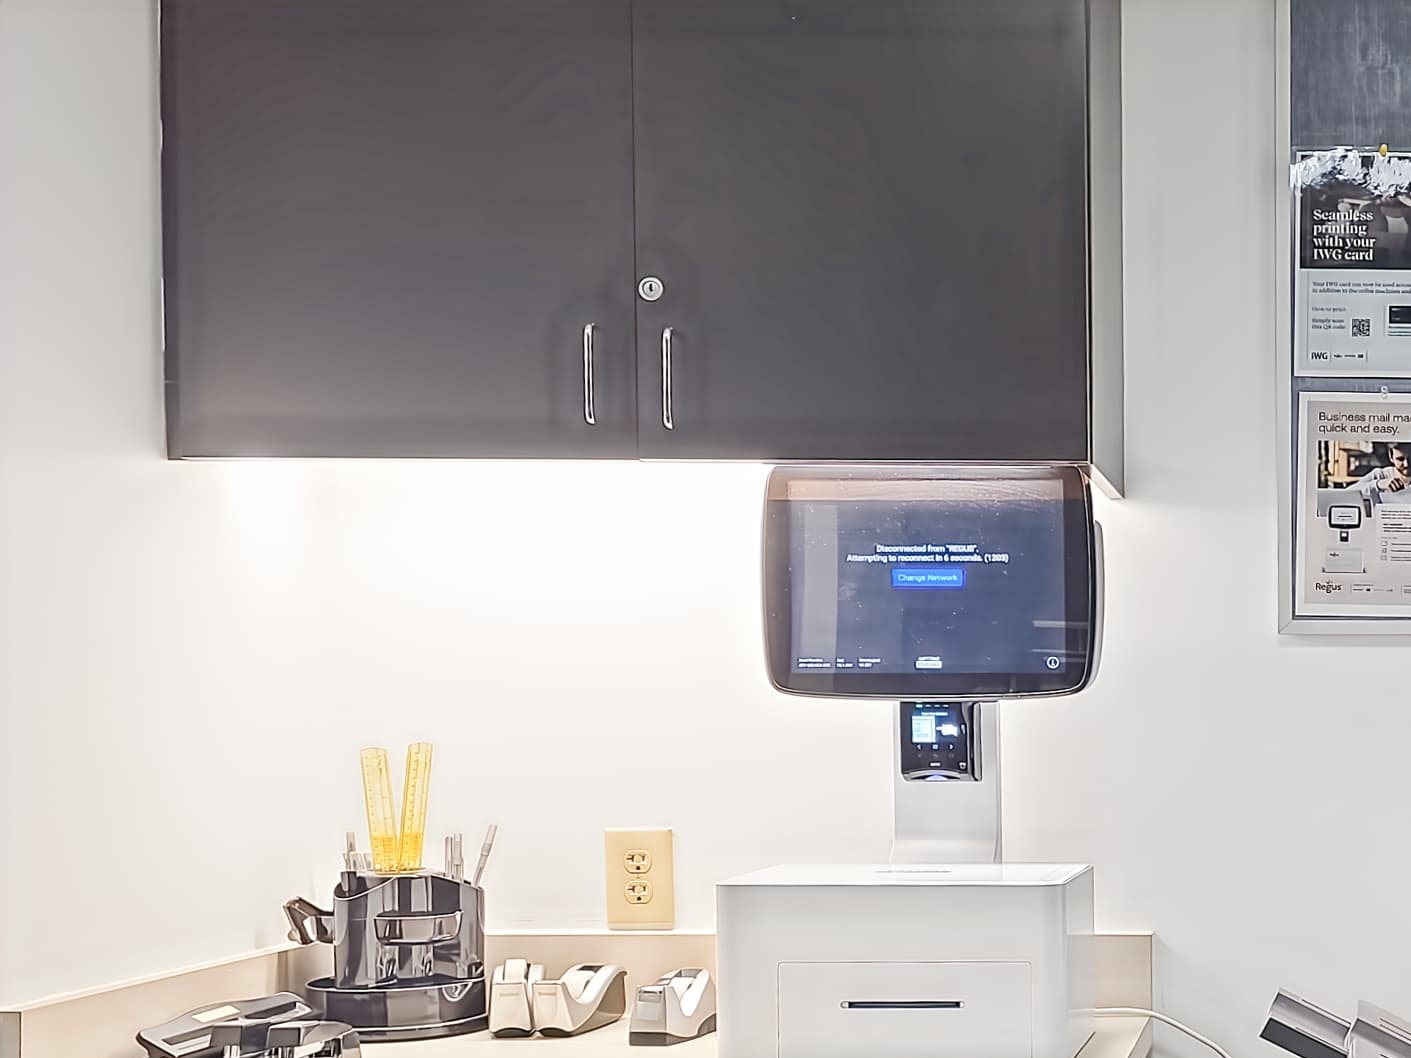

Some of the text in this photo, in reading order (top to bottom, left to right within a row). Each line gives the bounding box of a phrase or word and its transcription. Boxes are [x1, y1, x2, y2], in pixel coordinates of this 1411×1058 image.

[1313, 209, 1375, 221] Seamless
[1313, 222, 1367, 237] printing
[1313, 235, 1377, 249] with your
[1313, 249, 1374, 260] IWG card
[1311, 351, 1328, 360] IWG
[1319, 412, 1366, 422] Business
[1369, 413, 1390, 422] mail
[1319, 423, 1399, 436] quick and easy.
[876, 545, 926, 553] Disconnected
[928, 545, 945, 553] from
[846, 554, 888, 563] Attempting
[888, 554, 897, 563] to
[898, 554, 935, 563] reconnect
[935, 554, 943, 563] in
[898, 574, 958, 582] Change Network
[1315, 581, 1342, 593] Regus
